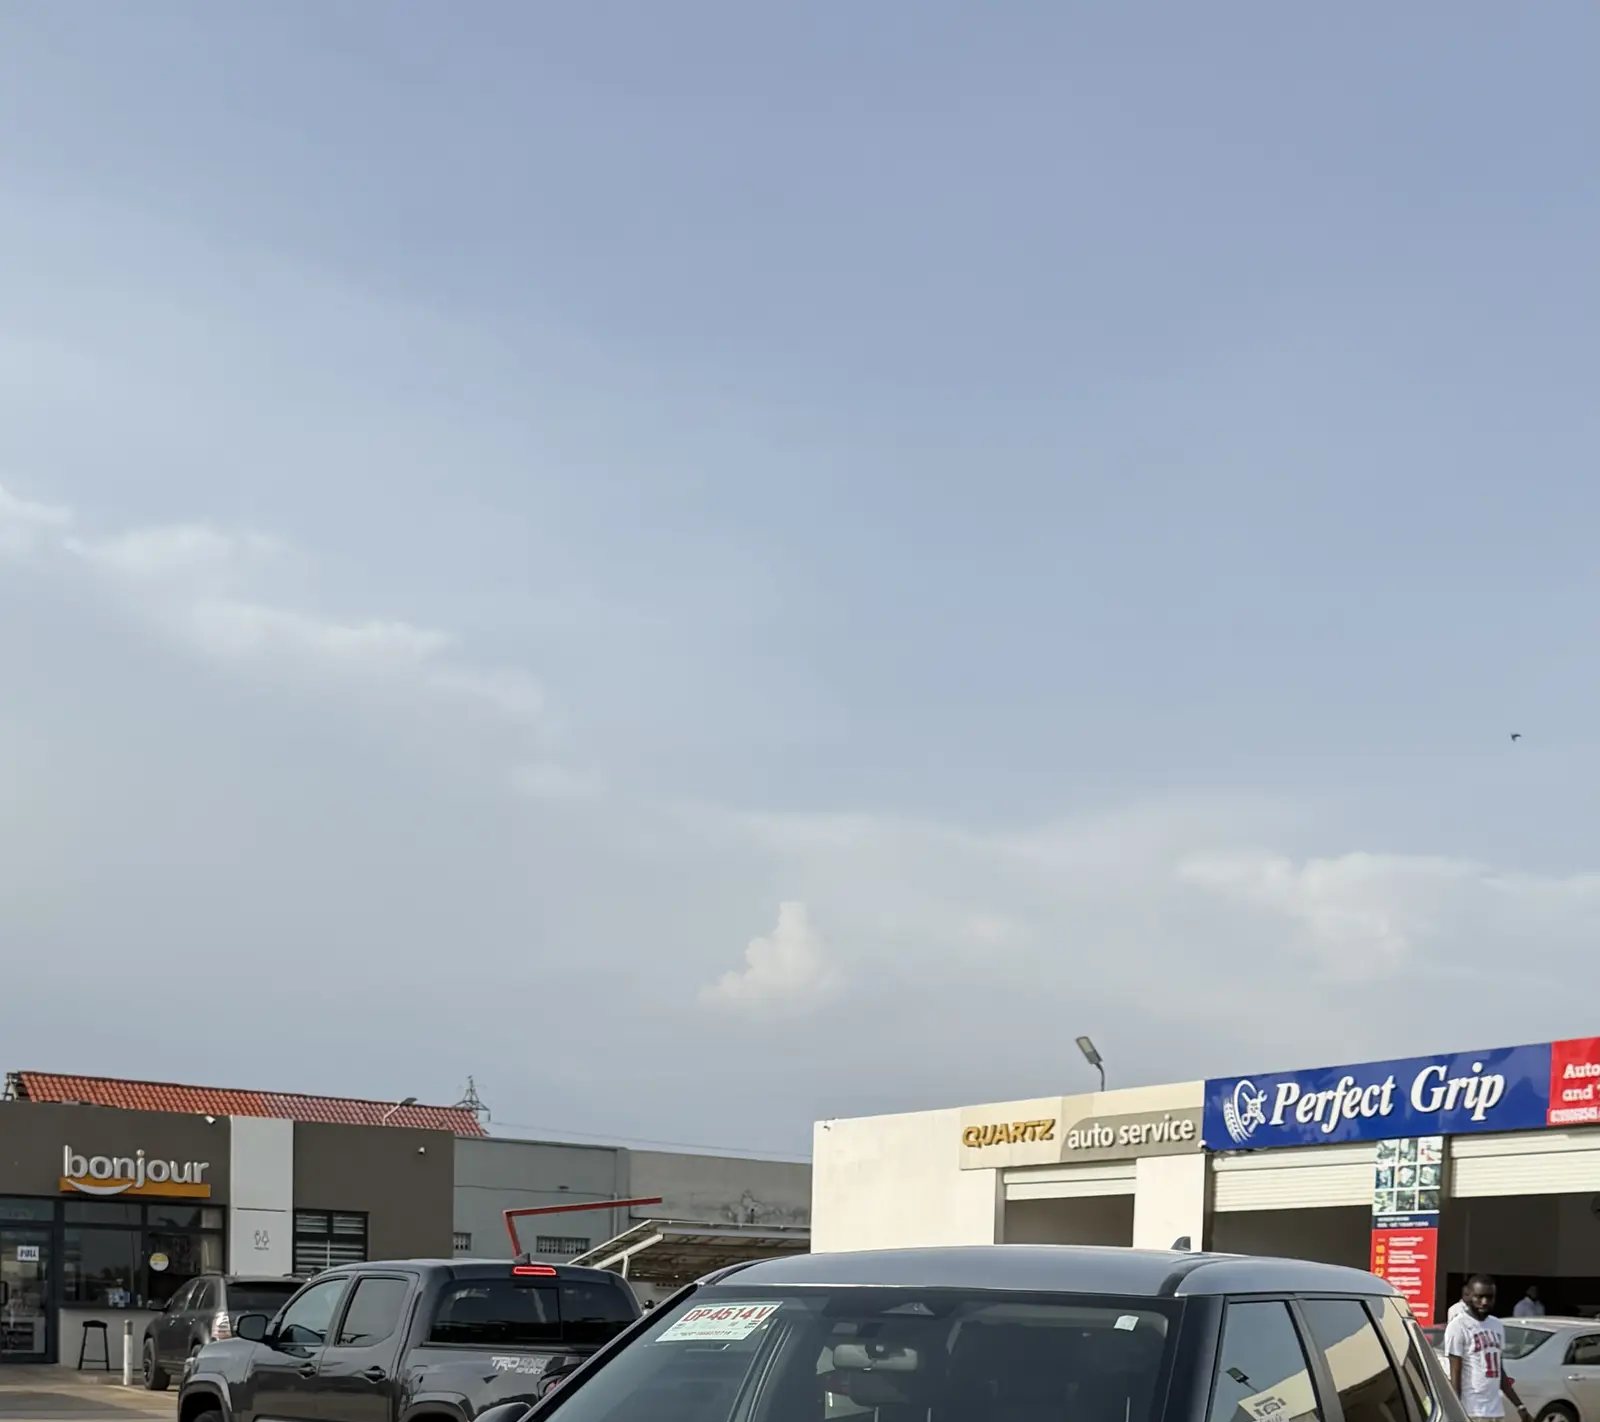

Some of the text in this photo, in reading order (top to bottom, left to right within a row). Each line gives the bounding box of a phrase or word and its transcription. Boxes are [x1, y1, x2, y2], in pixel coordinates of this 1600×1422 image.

[1562, 1061, 1600, 1079] Auto
[1269, 1062, 1505, 1133] Perfect Grip
[1562, 1084, 1594, 1101] and
[962, 1118, 1056, 1148] QUARTZ
[1067, 1114, 1195, 1149] auto service
[63, 1144, 210, 1188] bonjour
[491, 1356, 520, 1371] TRD
